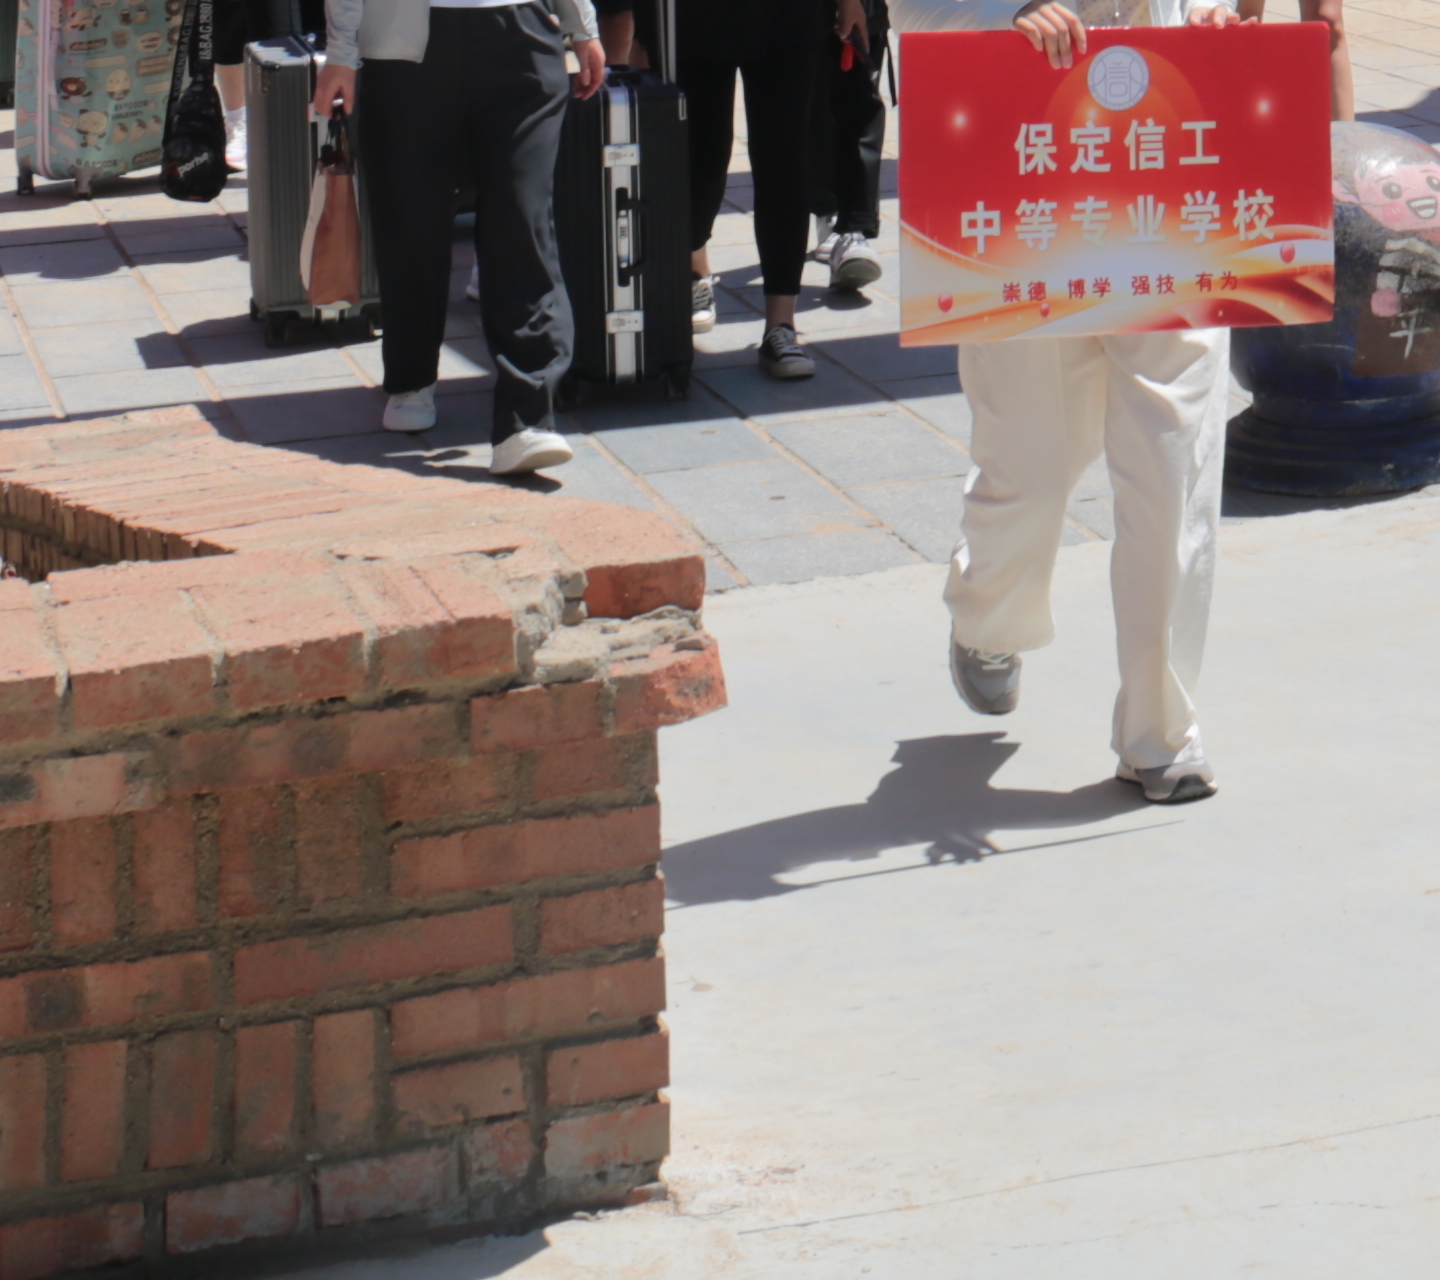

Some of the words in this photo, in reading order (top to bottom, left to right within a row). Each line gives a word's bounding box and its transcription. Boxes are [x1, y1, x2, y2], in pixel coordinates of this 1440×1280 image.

[1014, 117, 1220, 176] 保定信工
[960, 188, 1276, 255] 中等专业学校
[1001, 281, 1048, 303] 崇德
[1067, 276, 1112, 300] 博学
[1131, 274, 1175, 296] 强技
[1195, 270, 1239, 292] 有为
